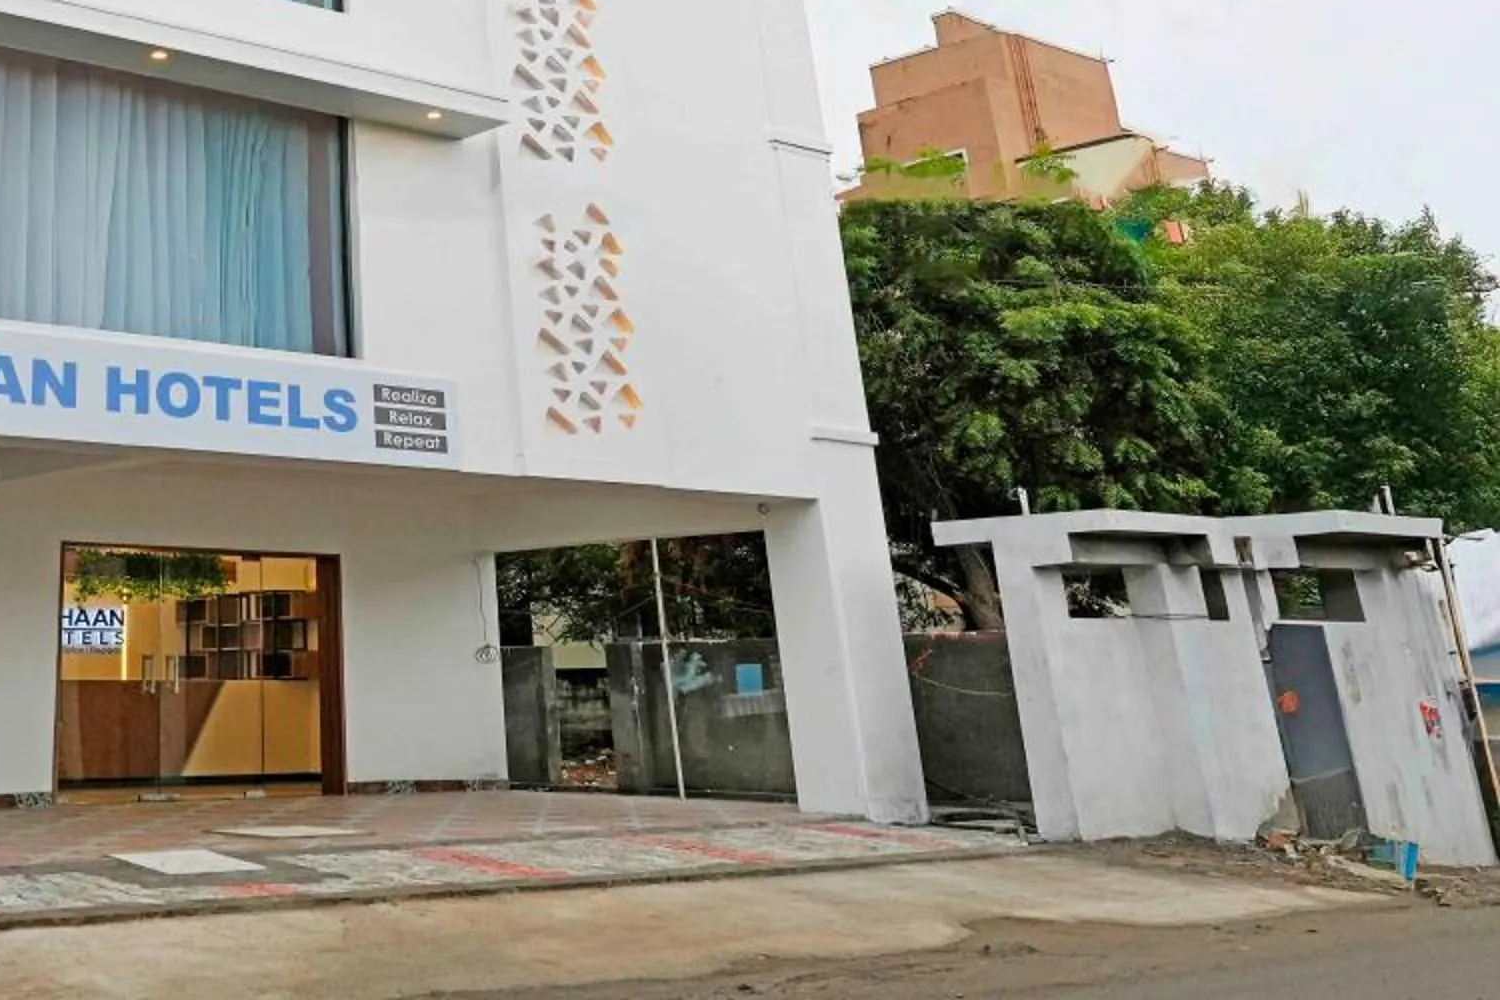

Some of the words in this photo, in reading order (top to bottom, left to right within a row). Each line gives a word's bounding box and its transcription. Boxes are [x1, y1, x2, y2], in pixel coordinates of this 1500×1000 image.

[106, 366, 358, 433] HOTELS
[381, 387, 437, 405] Realize
[389, 409, 433, 427] Relax
[383, 431, 440, 449] Repeat
